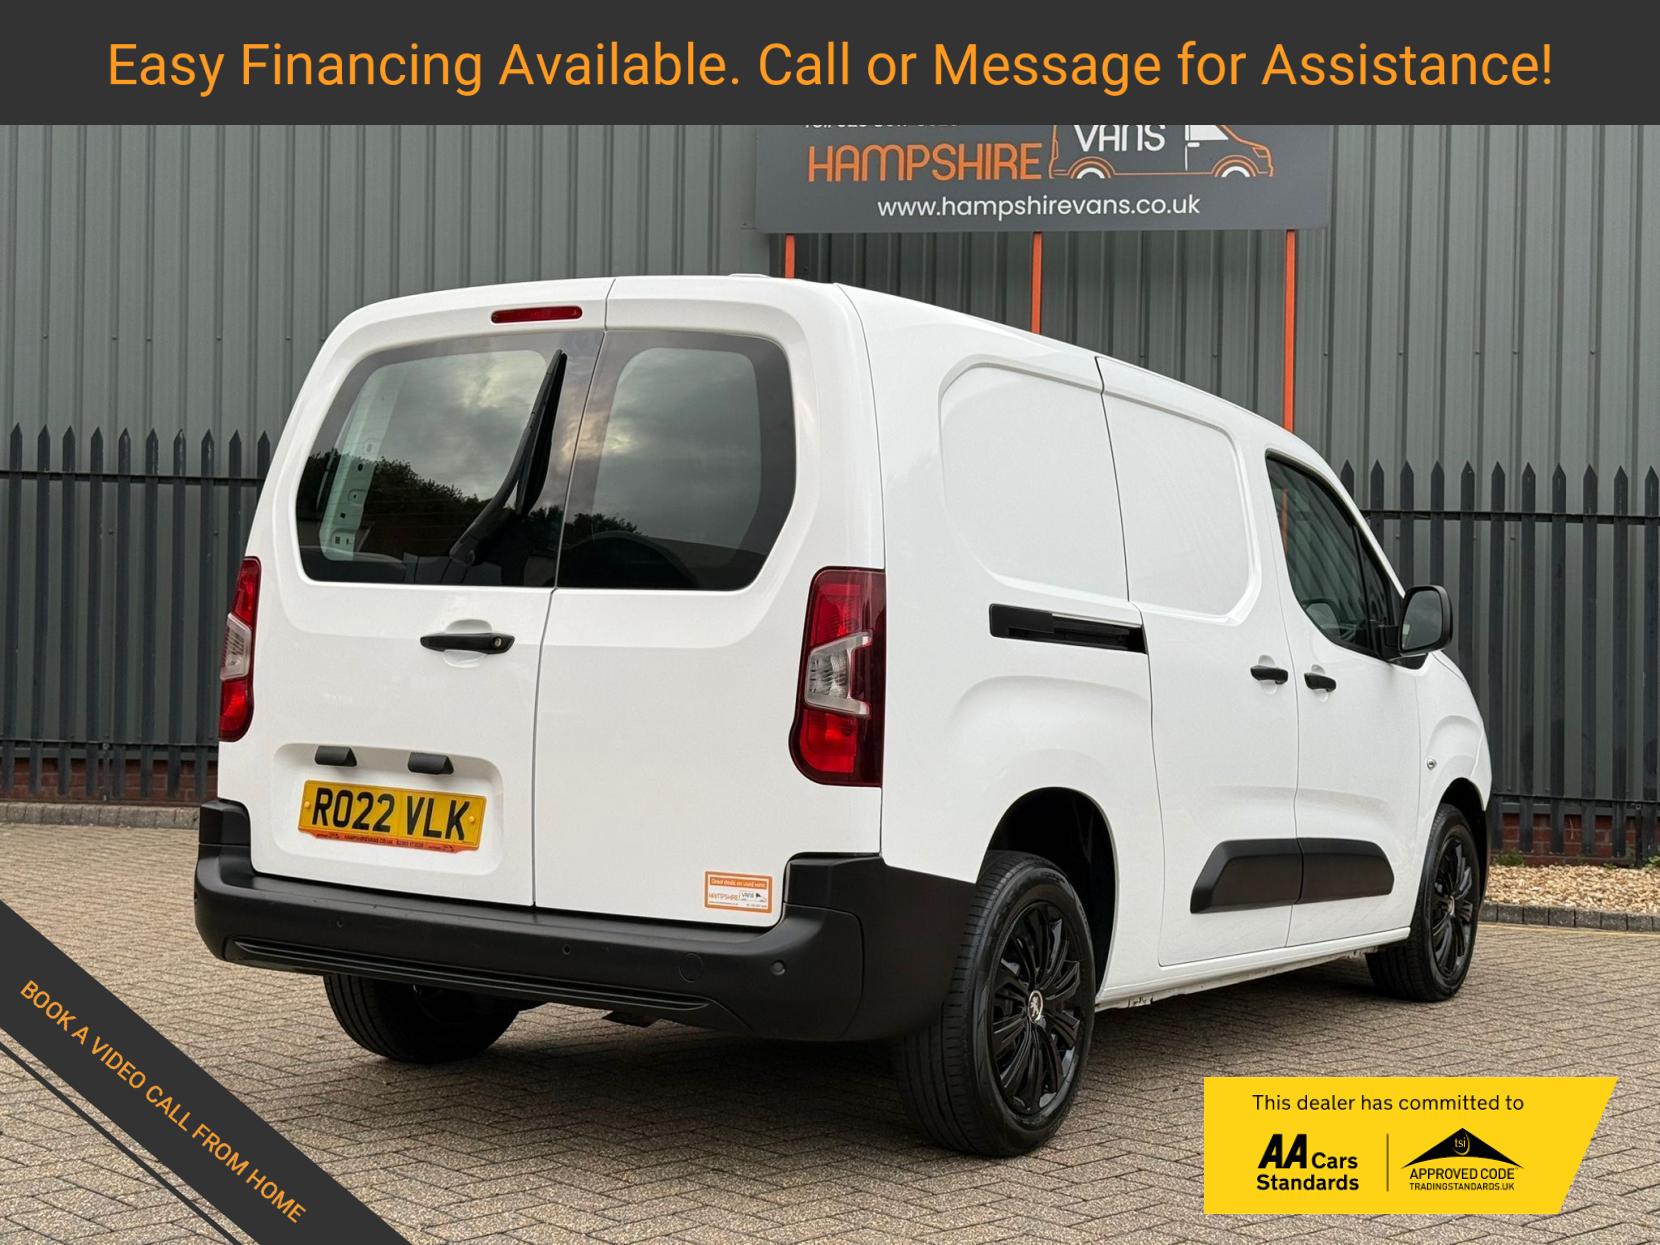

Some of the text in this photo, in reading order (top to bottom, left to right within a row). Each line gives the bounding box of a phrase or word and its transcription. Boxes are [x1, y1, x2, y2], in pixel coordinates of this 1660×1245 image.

[1073, 124, 1166, 152] VANS
[807, 142, 1042, 183] HAMPSHIRE
[877, 194, 1201, 222] www.hampshirevans.co.uk
[311, 786, 471, 841] RO22 VLK
